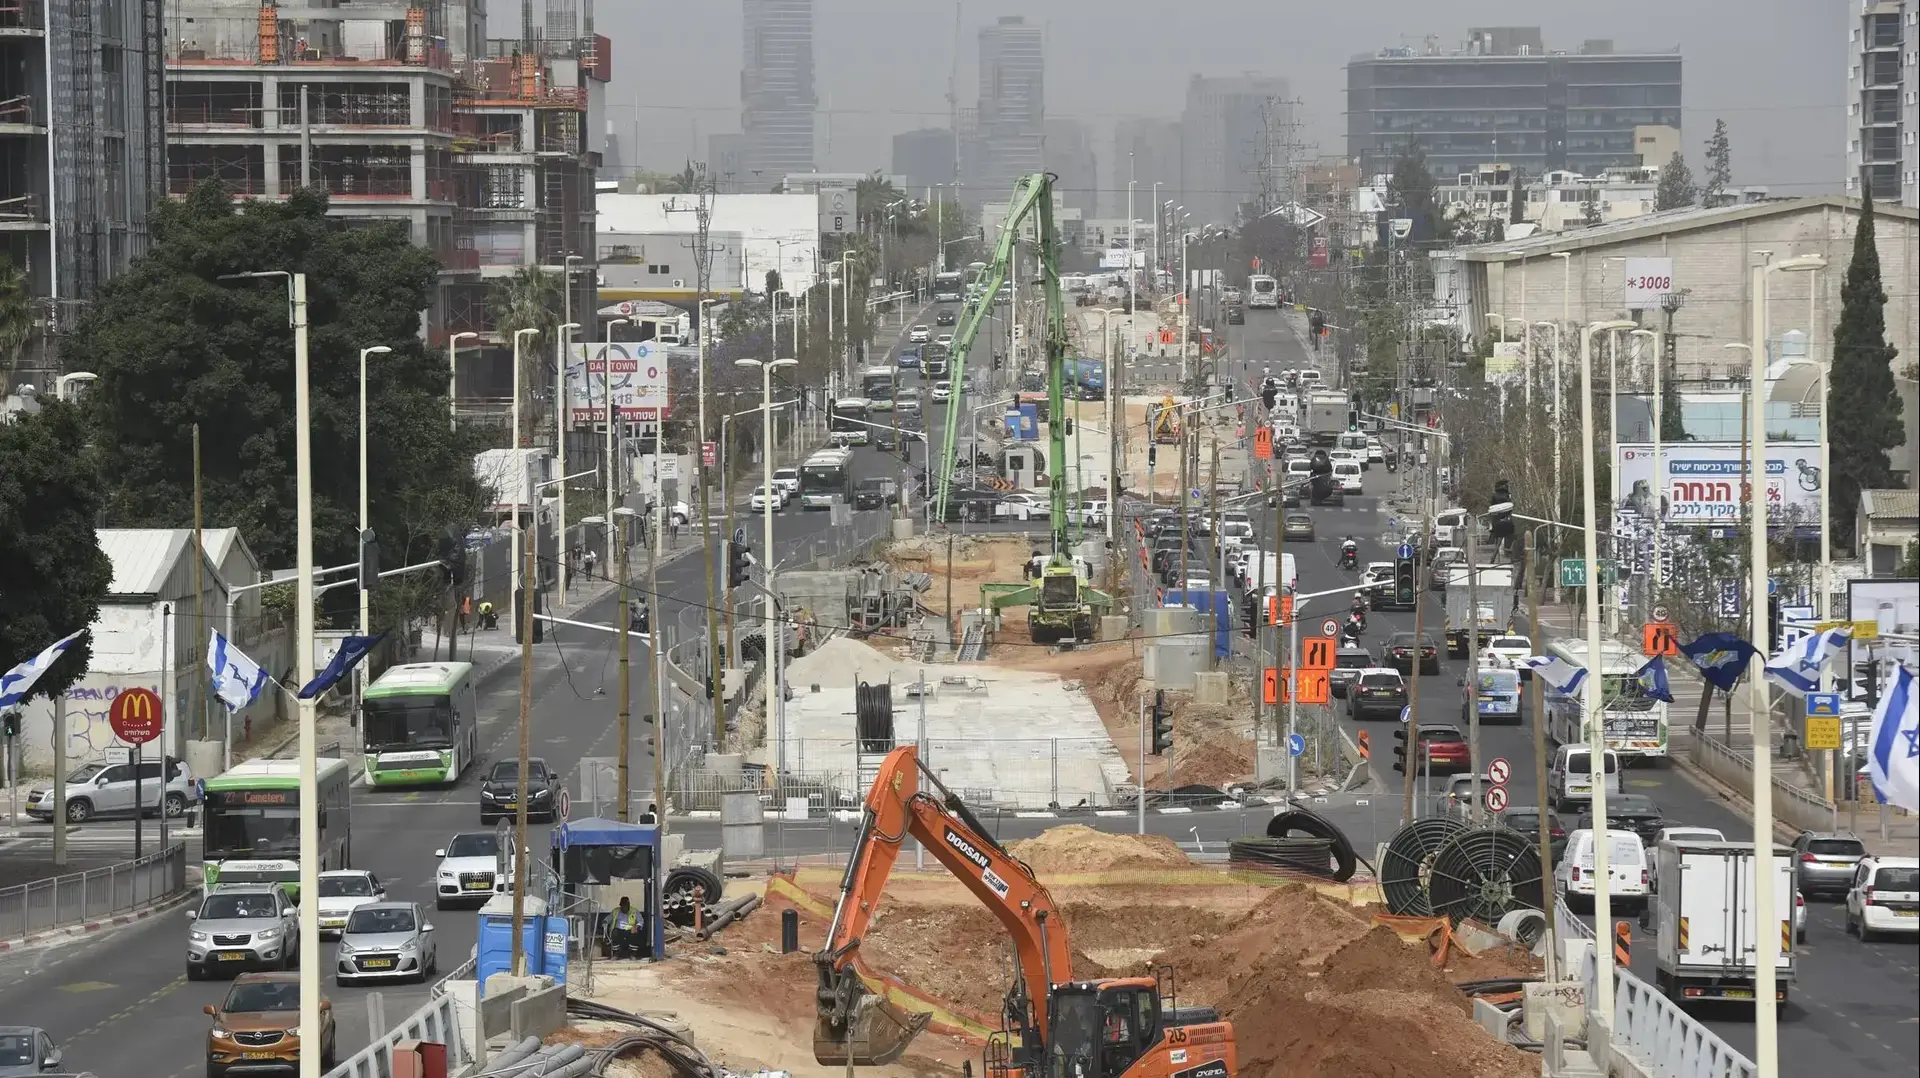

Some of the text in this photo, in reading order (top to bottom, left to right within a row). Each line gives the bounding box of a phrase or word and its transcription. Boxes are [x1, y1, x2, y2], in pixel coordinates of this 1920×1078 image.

[1673, 482, 1732, 502] הנחה
[1673, 502, 1736, 517] מקיף לרכב
[1325, 624, 1335, 633] 40
[244, 791, 287, 804] Cemetery
[946, 831, 988, 867] DOOSAN
